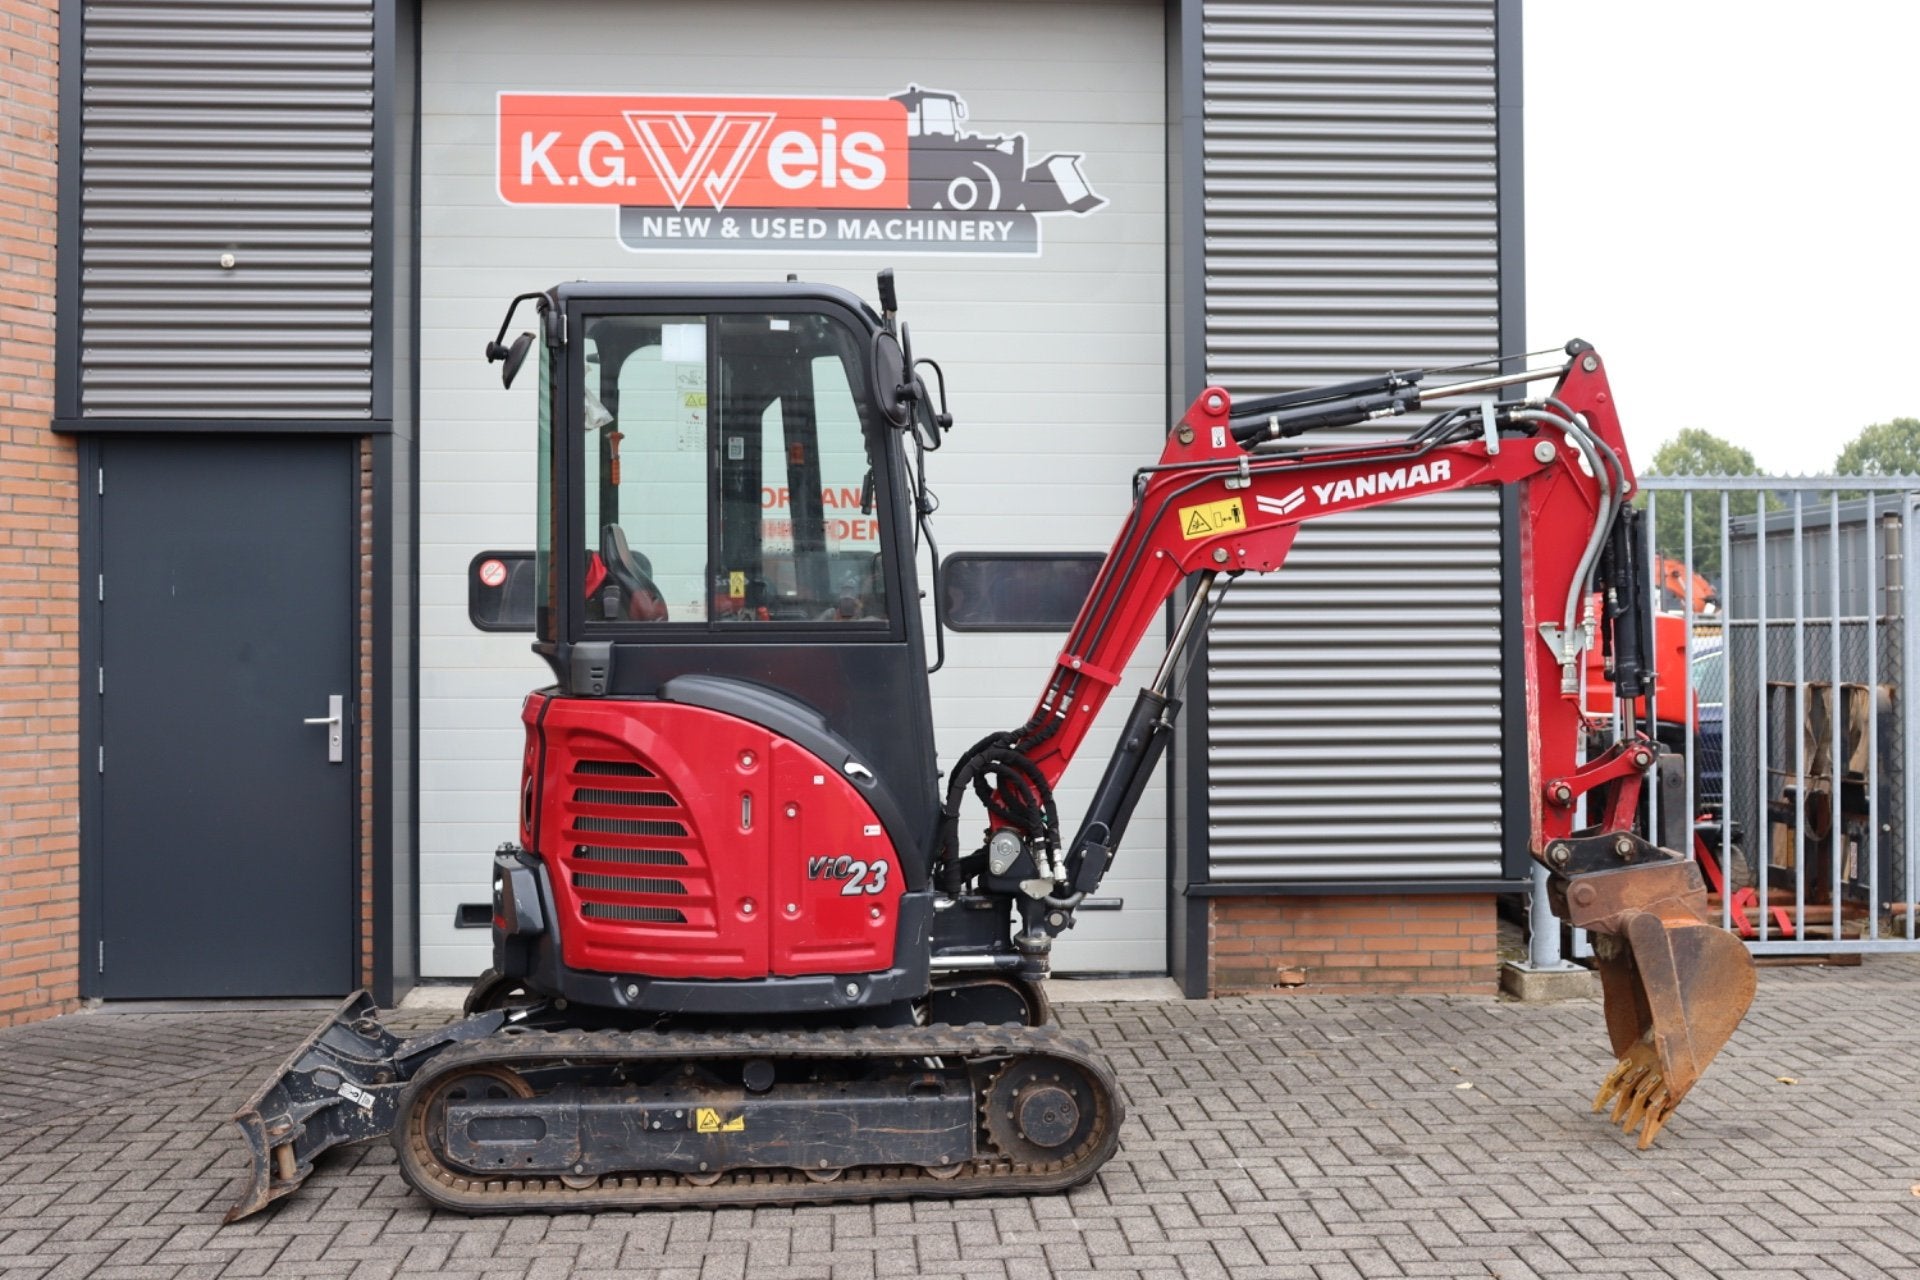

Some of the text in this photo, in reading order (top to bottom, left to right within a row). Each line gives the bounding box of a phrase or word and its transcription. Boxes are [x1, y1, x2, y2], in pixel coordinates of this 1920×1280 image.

[520, 130, 637, 188] K.G.
[642, 216, 1014, 241] NEW & USED MACHINERY
[1312, 459, 1451, 505] YANMAR
